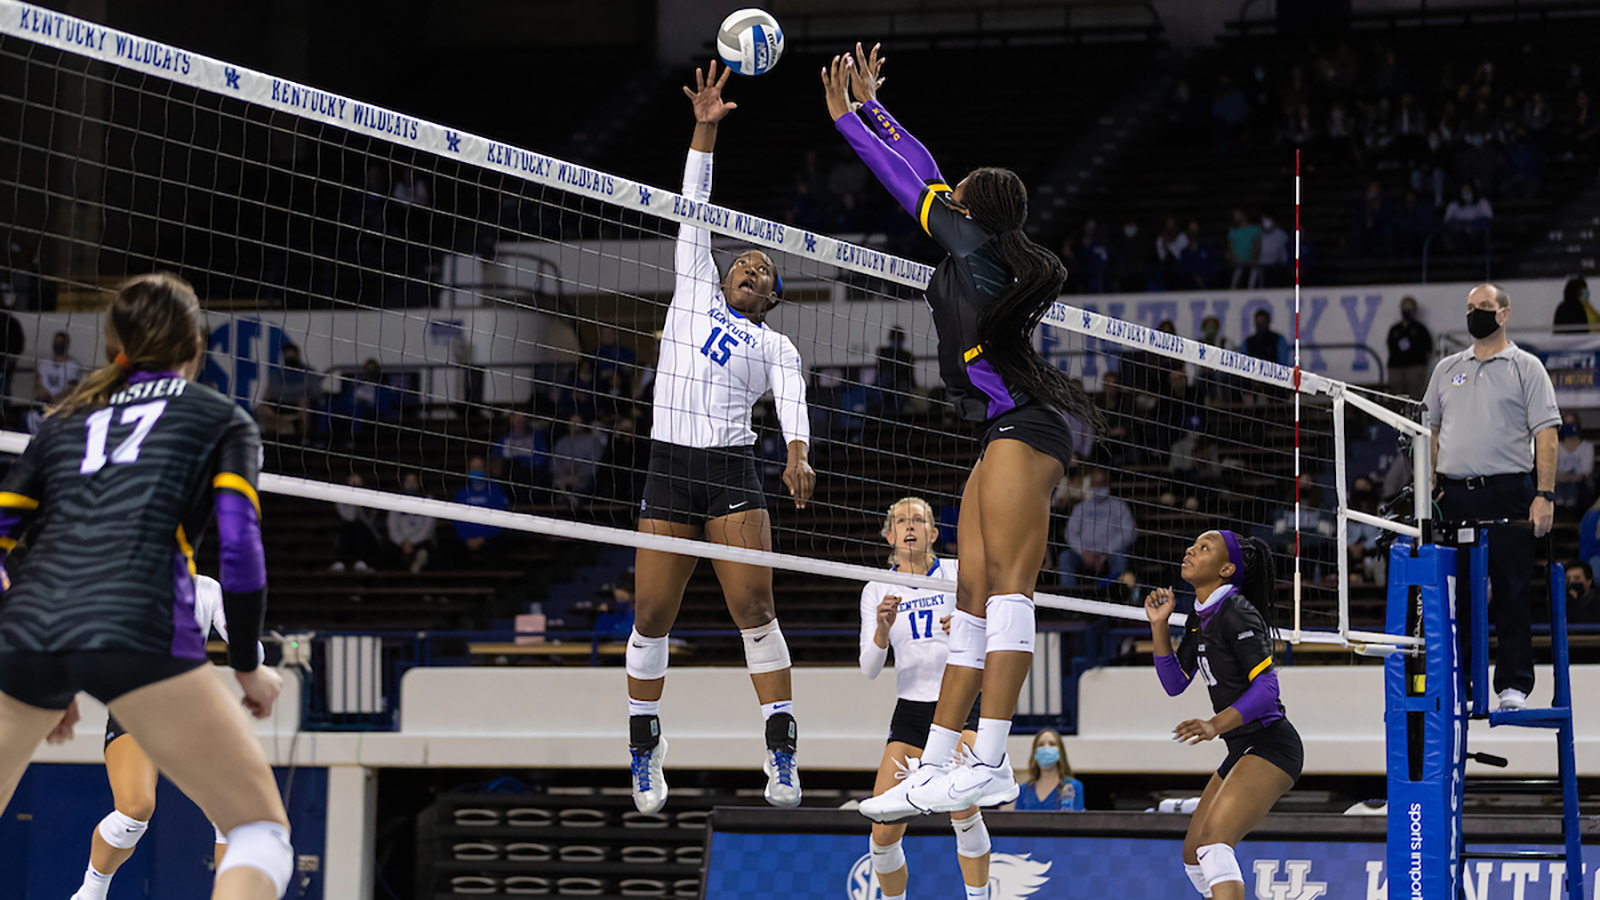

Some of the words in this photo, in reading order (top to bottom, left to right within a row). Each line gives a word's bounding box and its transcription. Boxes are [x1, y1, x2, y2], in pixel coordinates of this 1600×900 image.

[756, 42, 768, 69] NCAA
[19, 7, 106, 52] KENTUCKY
[115, 34, 191, 75] WILDCATS
[271, 79, 346, 120] KENTUCKY
[353, 105, 419, 141] WILDCATS
[487, 142, 551, 178] KENTUCKY
[557, 160, 615, 196] WILDCATS
[673, 195, 731, 229] KENTUCKY
[735, 213, 785, 244] WILDCATS
[836, 242, 886, 278] KENTUCKY
[889, 256, 934, 284] WILDCATS
[1105, 317, 1146, 344] KENTUCKY
[1149, 330, 1185, 355] WILDCATS
[1219, 349, 1256, 375] KENTUCKY
[1258, 360, 1291, 382] WILDCATS
[700, 326, 739, 367] 15
[707, 307, 758, 349] KENTUCKY
[80, 400, 168, 474] 17
[898, 594, 945, 613] ENTUCKY
[908, 609, 933, 640] 17
[1407, 803, 1423, 850] sports
